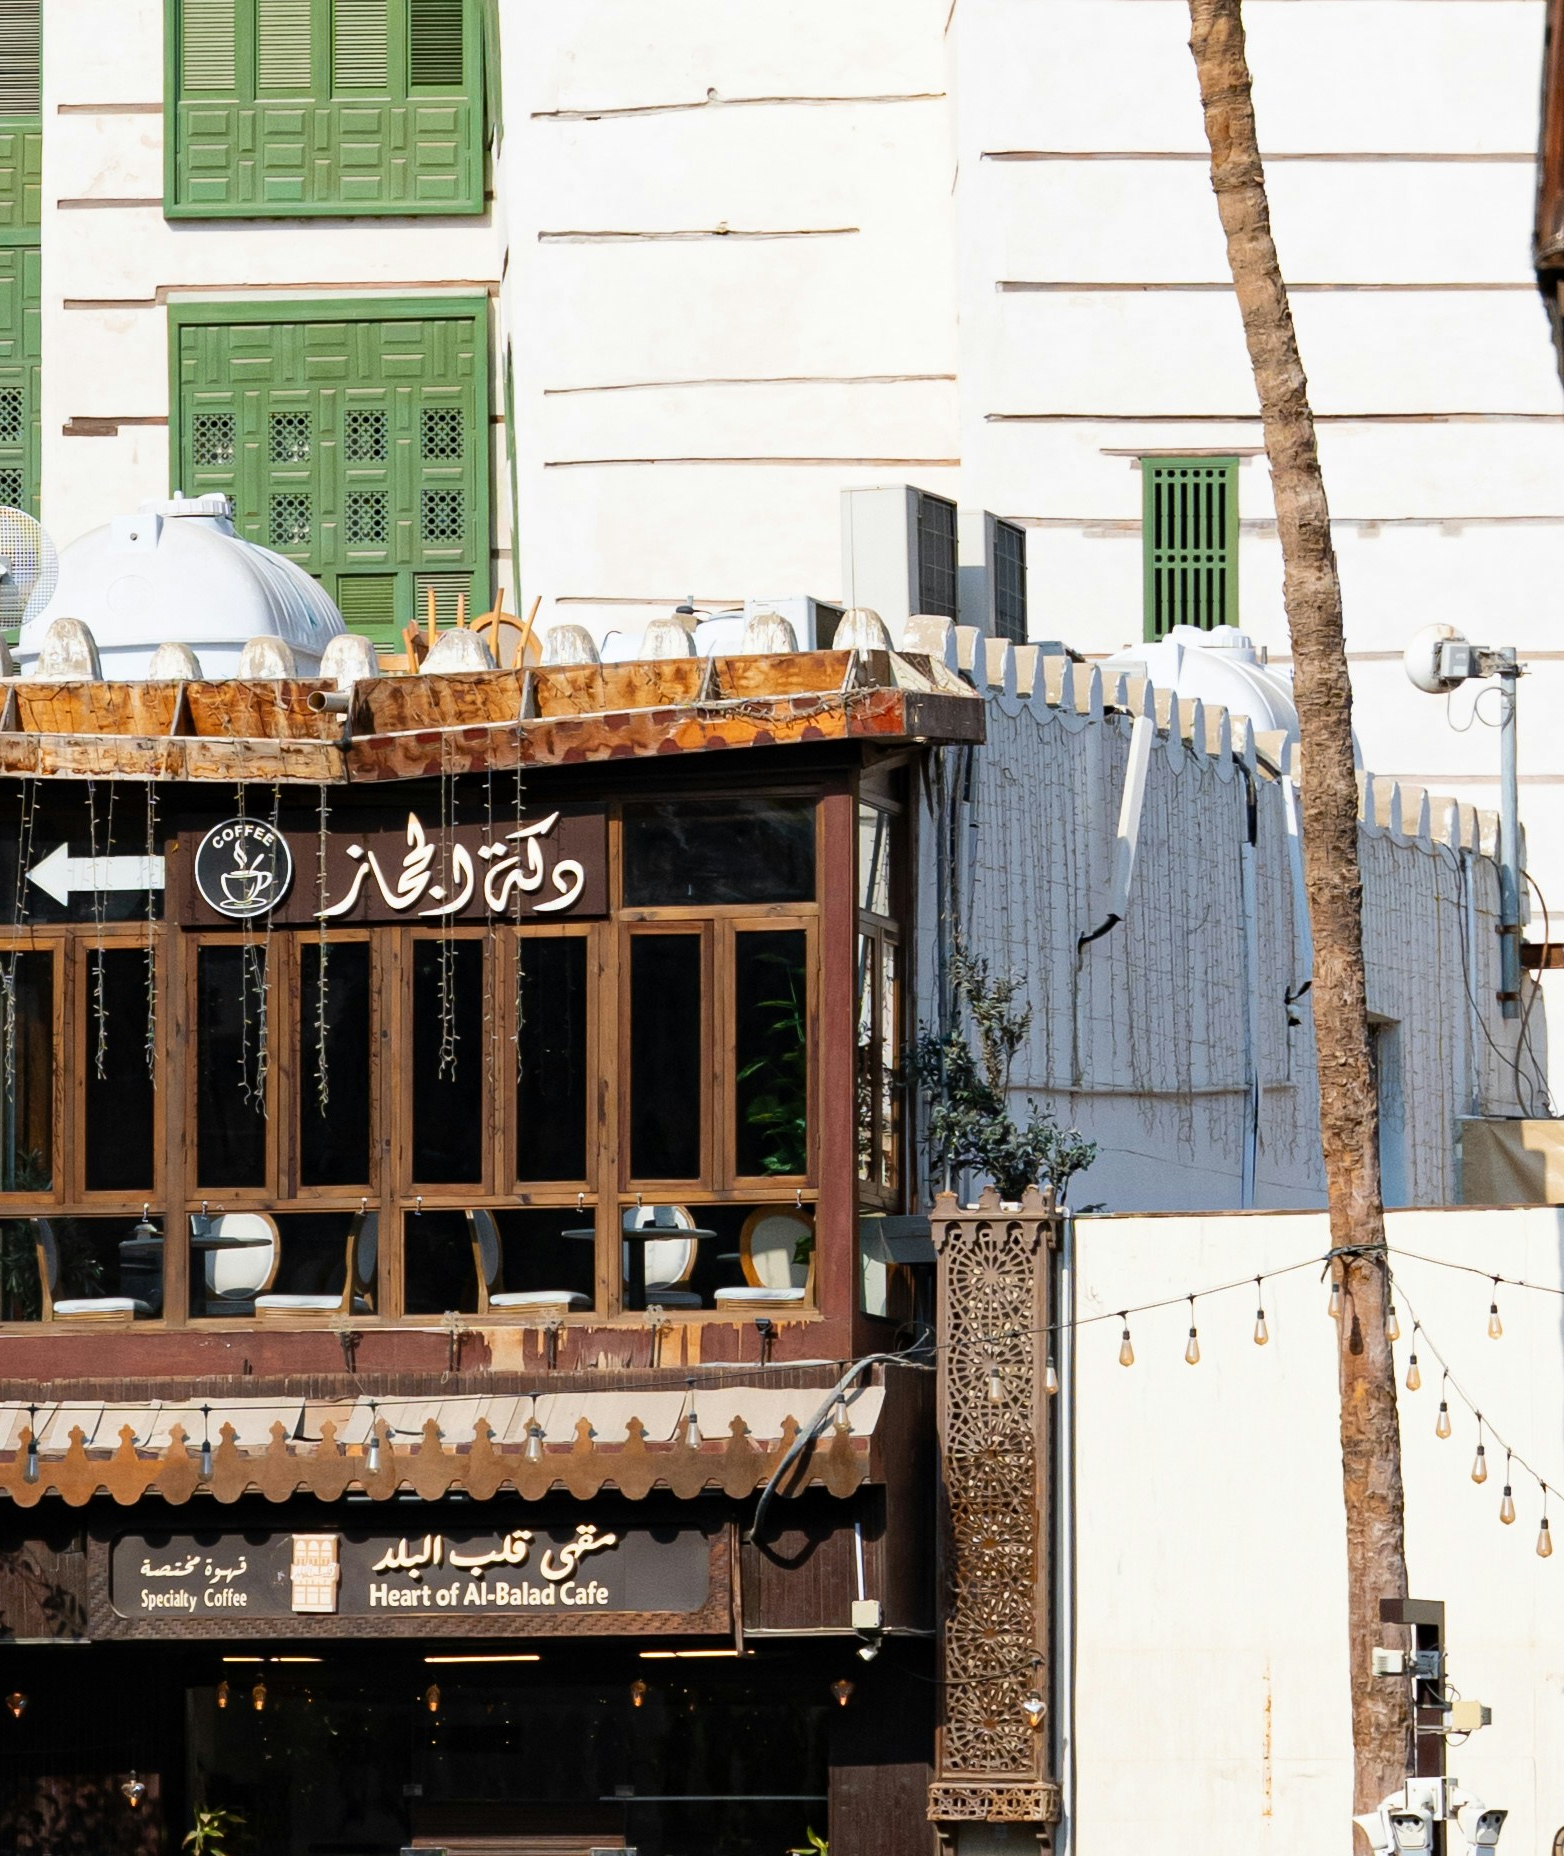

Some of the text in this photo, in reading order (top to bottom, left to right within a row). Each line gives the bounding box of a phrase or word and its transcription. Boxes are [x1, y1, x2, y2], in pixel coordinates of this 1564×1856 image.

[211, 824, 275, 849] COFFEE
[313, 811, 585, 917] دكة الحجاز
[371, 1524, 617, 1581] مقهى قلب البلد
[140, 1554, 248, 1584] قهوة مختصة
[141, 1588, 248, 1612] Specialty Coffee
[369, 1580, 609, 1607] Heart of Al-Balad Cafe
